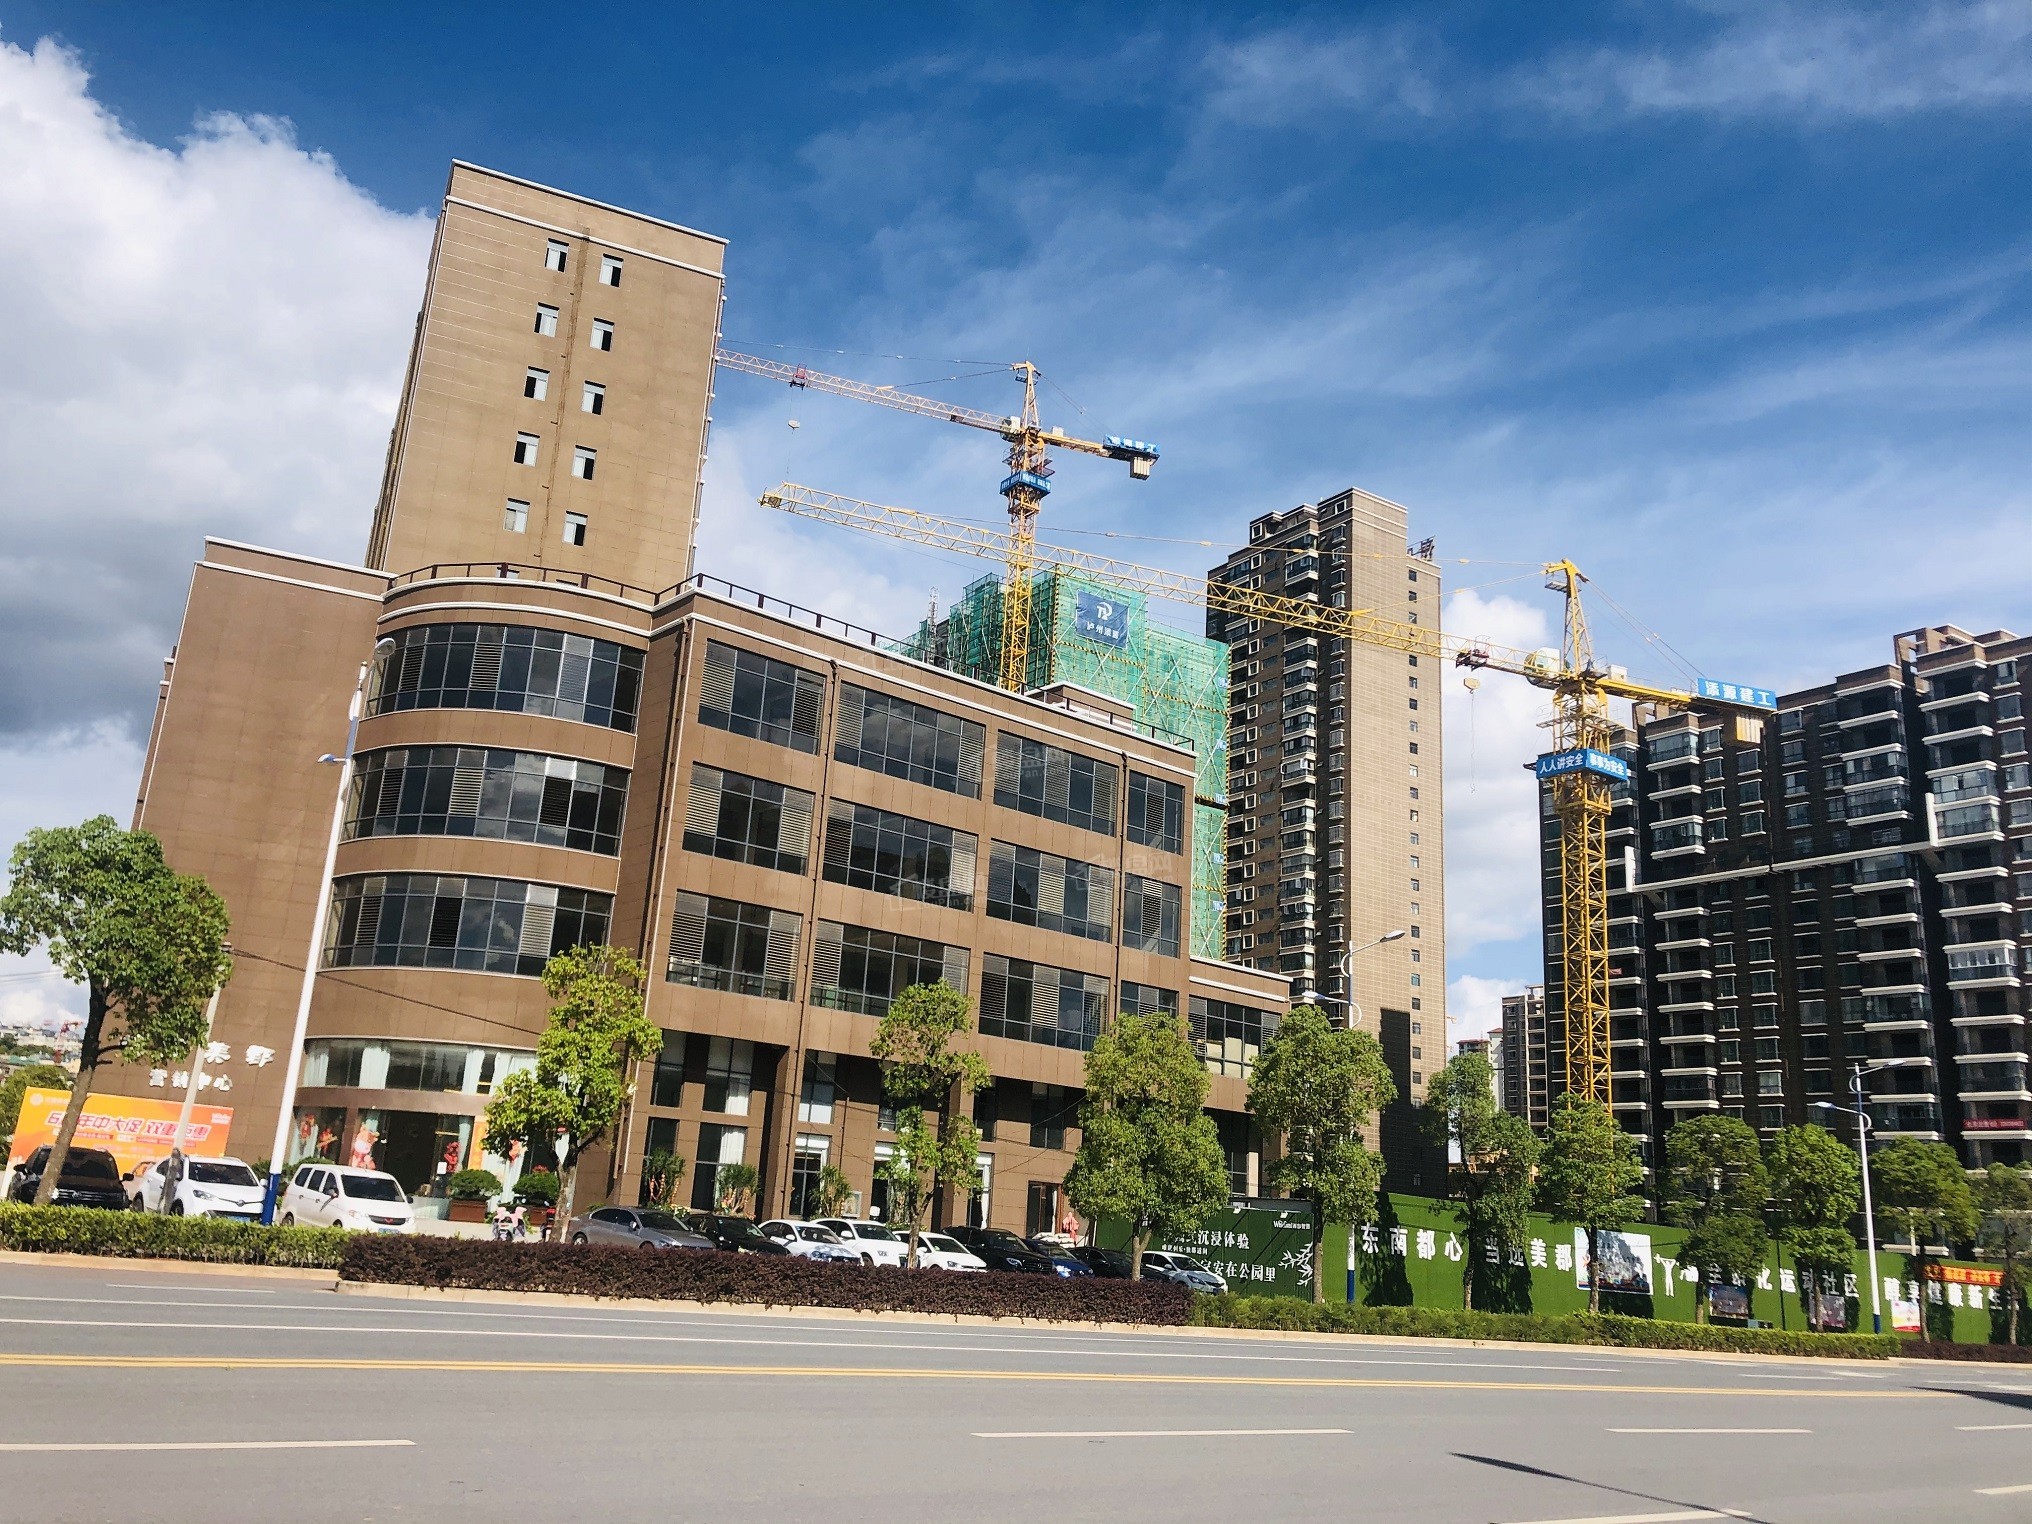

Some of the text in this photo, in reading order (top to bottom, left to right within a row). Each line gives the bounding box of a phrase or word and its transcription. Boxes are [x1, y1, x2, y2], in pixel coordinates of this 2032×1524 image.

[1540, 753, 1583, 774] 人人讲安全
[1361, 1222, 1464, 1262] 东南都心
